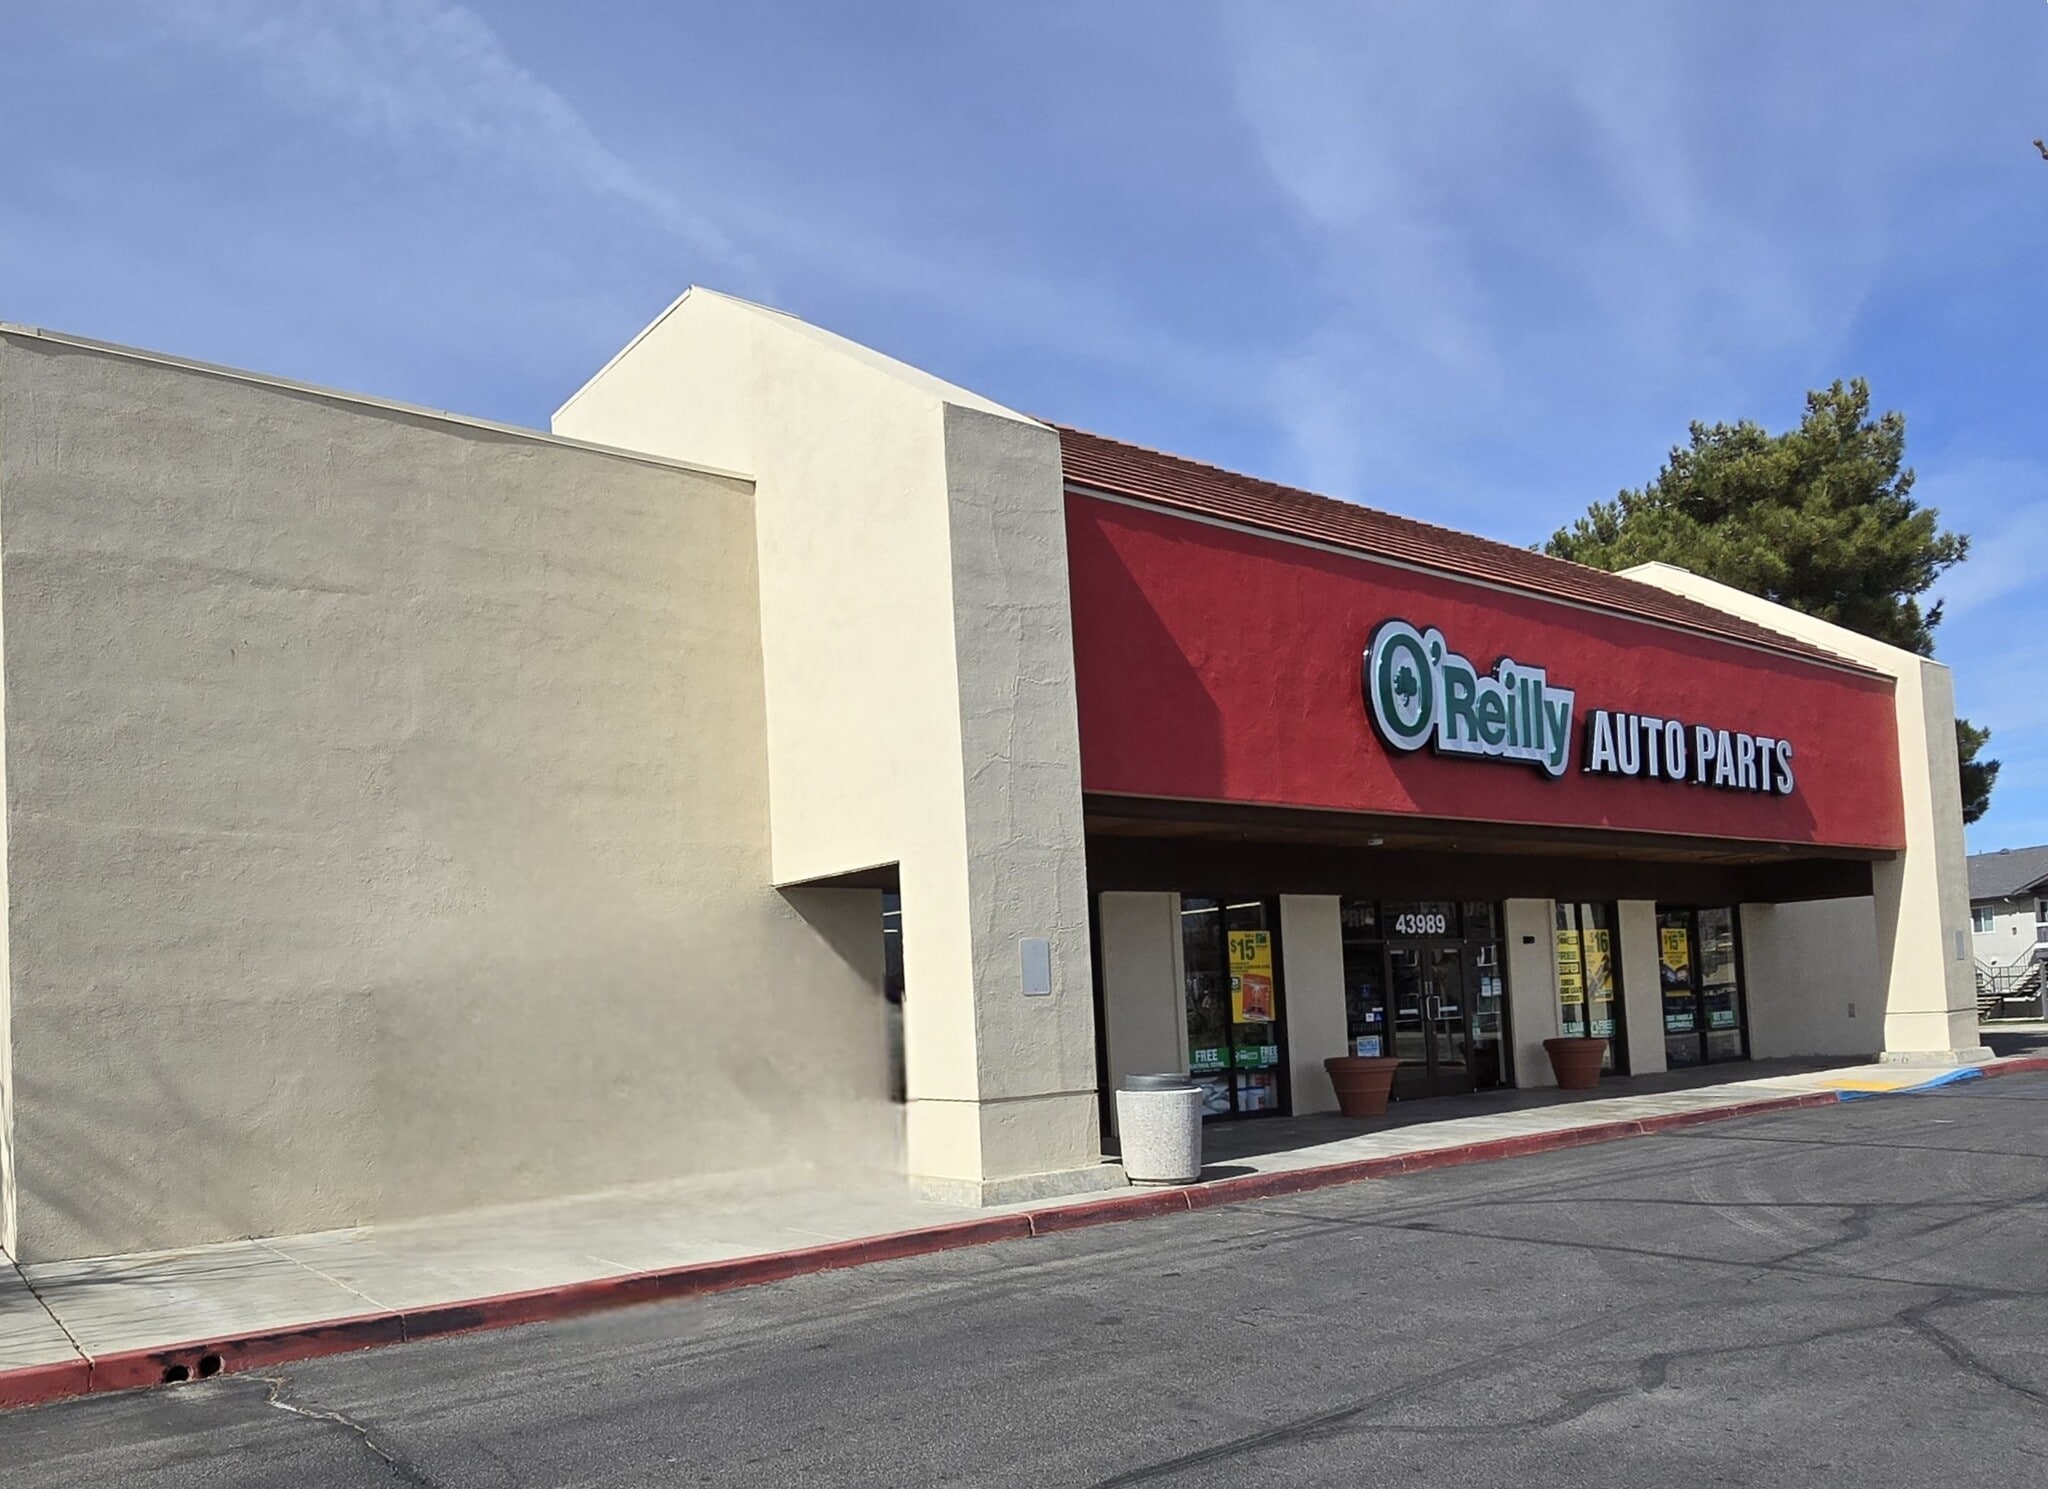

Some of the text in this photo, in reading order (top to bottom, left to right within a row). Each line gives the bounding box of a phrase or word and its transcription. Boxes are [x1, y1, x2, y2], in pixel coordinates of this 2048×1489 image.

[1371, 622, 1795, 795] O'Reilly AUTO PARTS
[1396, 913, 1446, 934] 43989
[1230, 939, 1256, 961] $15
[1589, 931, 1609, 953] $16
[1195, 1049, 1218, 1063] FREE
[1260, 1045, 1278, 1057] FREE
